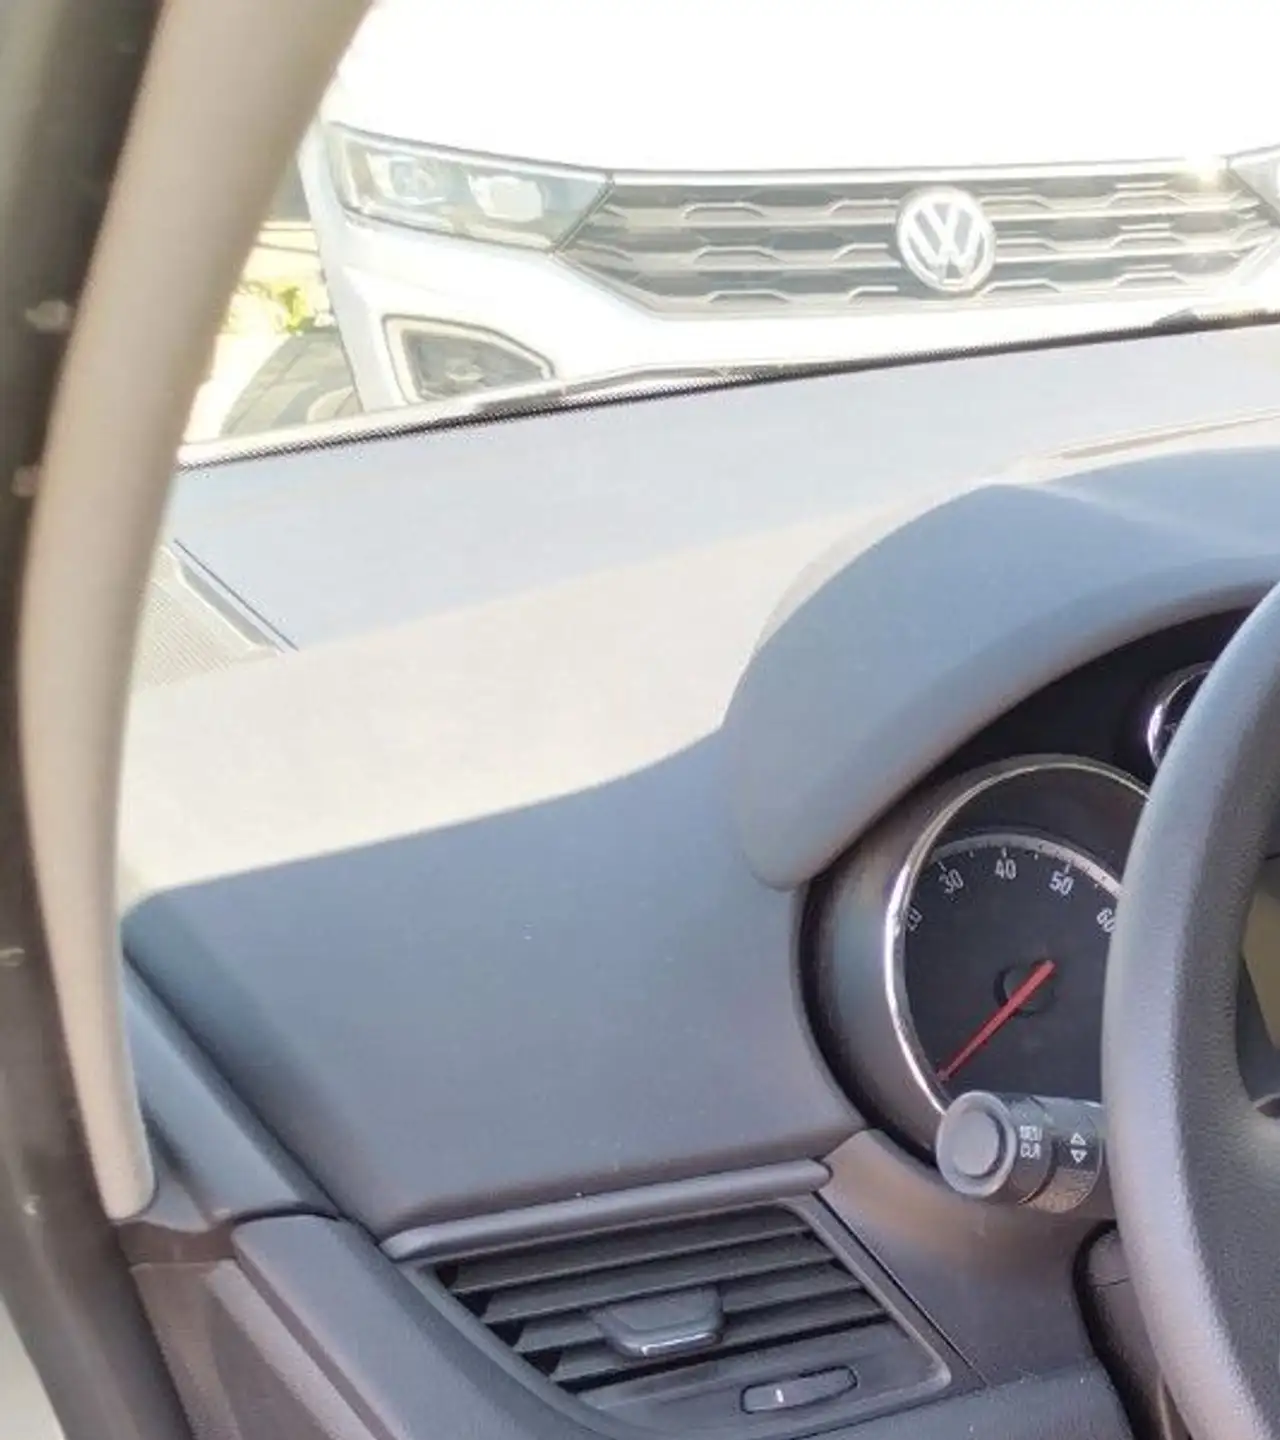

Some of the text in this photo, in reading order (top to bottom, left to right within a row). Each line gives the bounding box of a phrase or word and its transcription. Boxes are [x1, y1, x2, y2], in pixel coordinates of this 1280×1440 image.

[939, 869, 964, 894] 30
[995, 858, 1017, 880] 40
[1049, 871, 1075, 896] 50
[1096, 907, 1116, 933] 60
